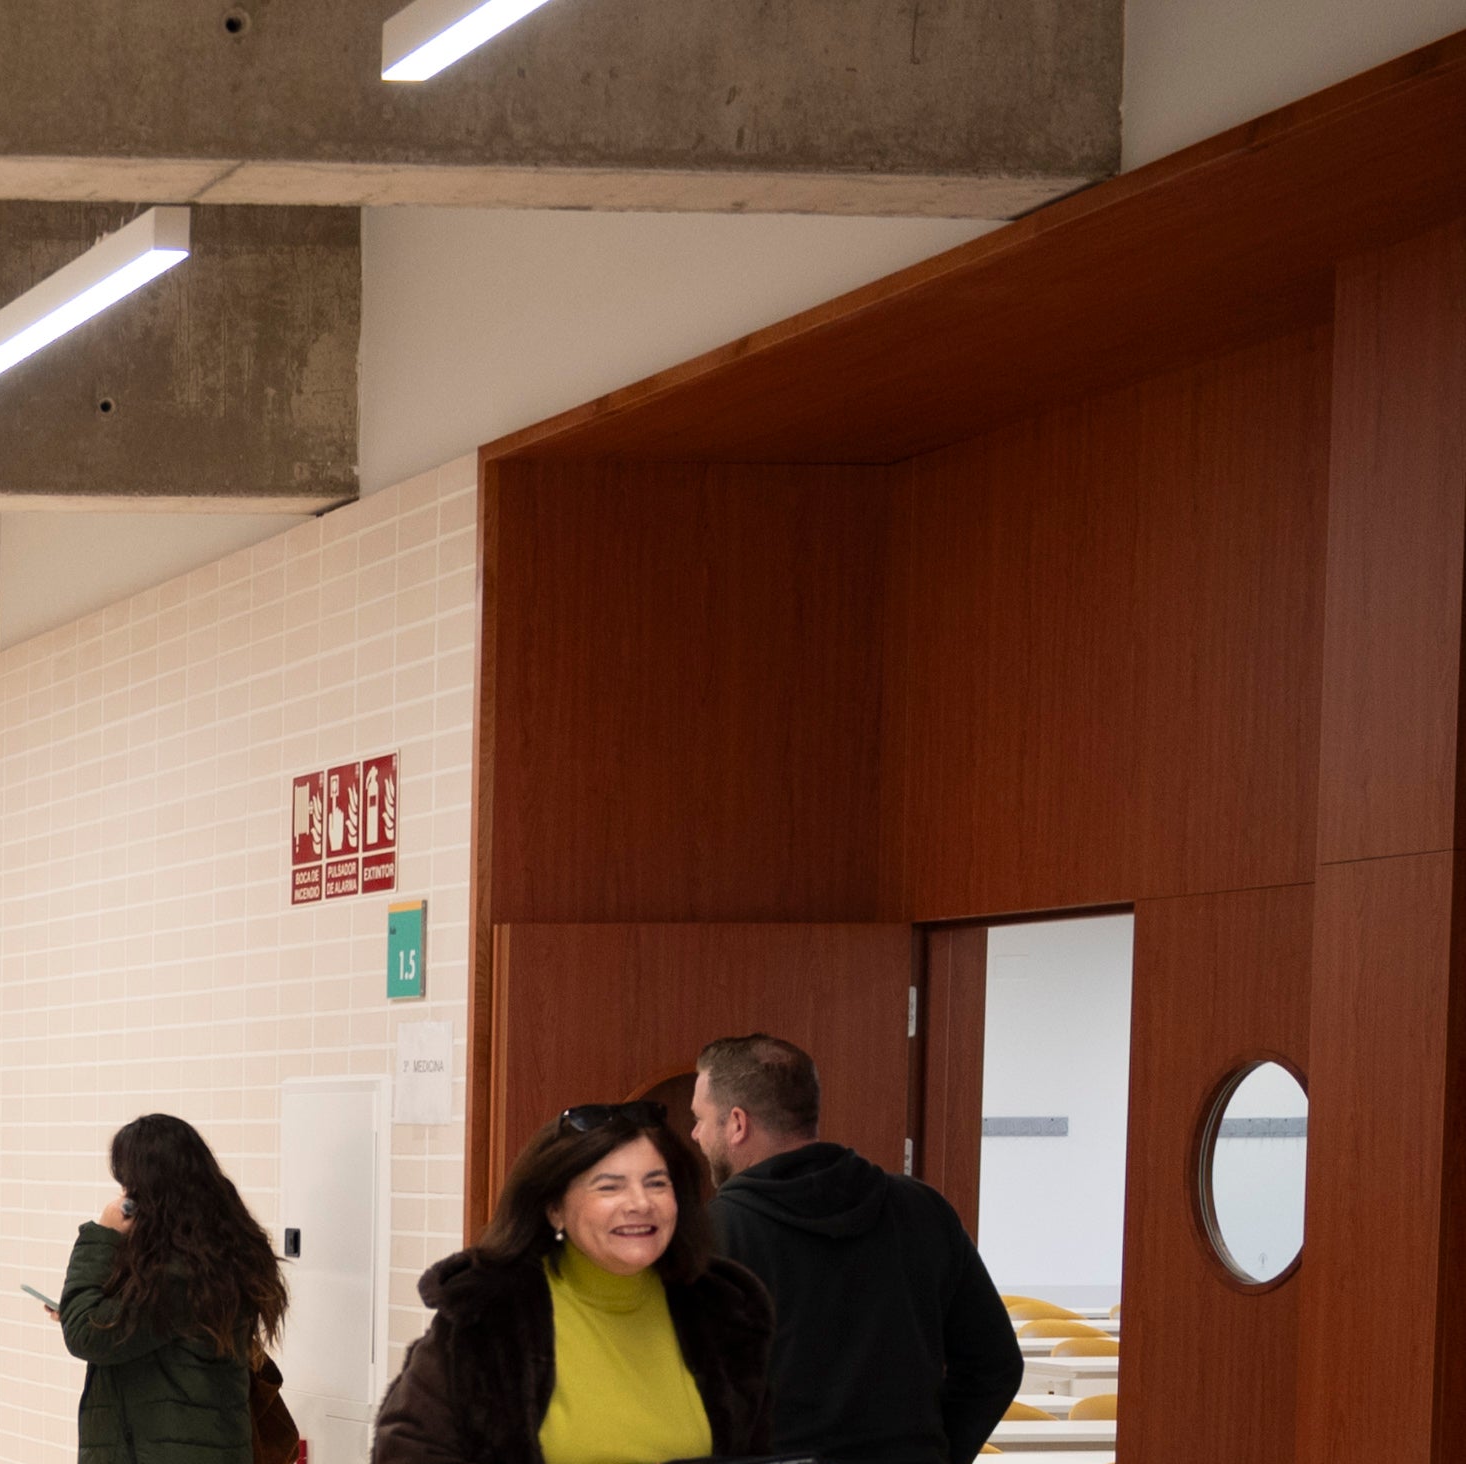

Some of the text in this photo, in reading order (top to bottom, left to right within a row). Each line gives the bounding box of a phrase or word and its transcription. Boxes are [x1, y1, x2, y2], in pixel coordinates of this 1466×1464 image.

[295, 869, 319, 885] BOCA DE
[328, 862, 356, 878] PULSADOR
[364, 863, 394, 881] EXTINTOR
[294, 885, 320, 901] INCENDIO
[327, 879, 357, 895] DE ALARMA
[399, 949, 416, 980] 1.5
